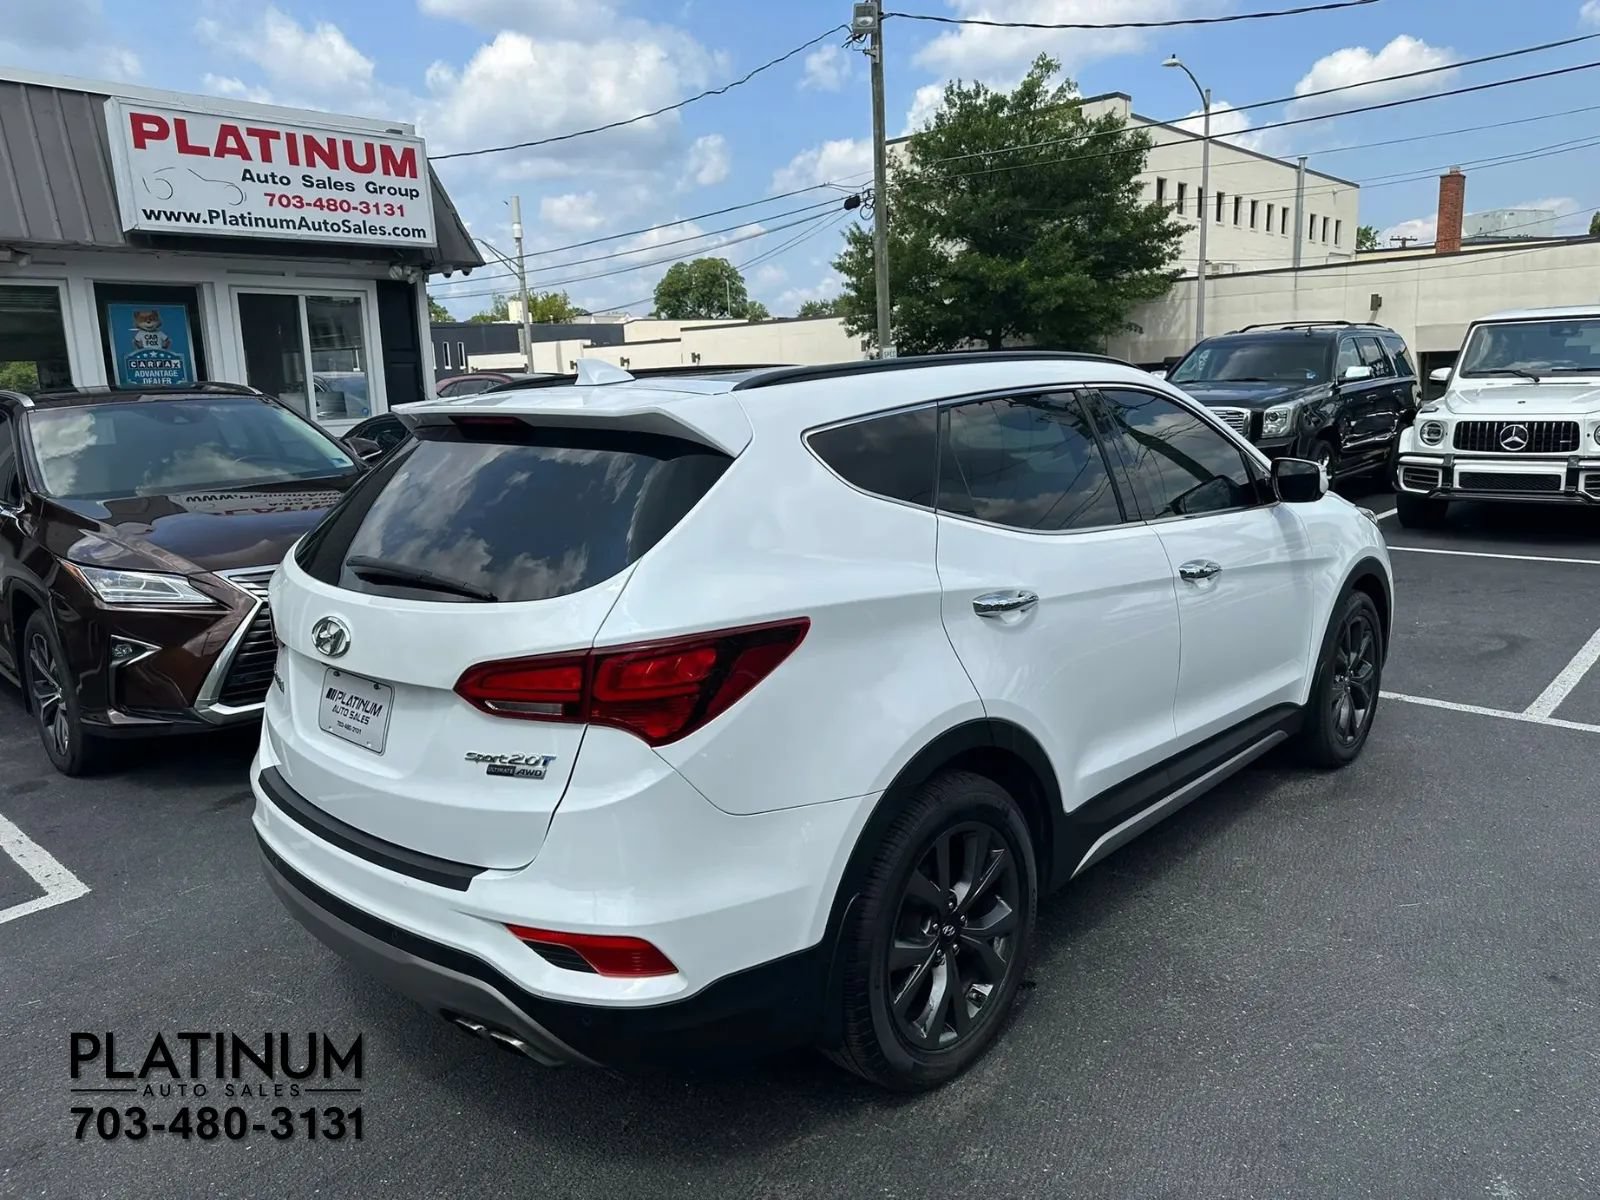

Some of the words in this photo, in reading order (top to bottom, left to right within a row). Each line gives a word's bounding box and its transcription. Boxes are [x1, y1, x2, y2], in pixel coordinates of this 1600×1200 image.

[129, 112, 419, 179] PLATINUM
[241, 168, 291, 187] Auto
[301, 174, 356, 193] Sales
[365, 181, 420, 200] Group
[263, 192, 405, 217] 703-480-3131
[142, 208, 427, 239] www.PlatinumAutoSales.com
[130, 360, 180, 369] CARFAX
[332, 704, 349, 717] AUTO
[349, 710, 371, 725] SALES
[335, 690, 383, 717] PLATINUM
[516, 768, 543, 777] AWD
